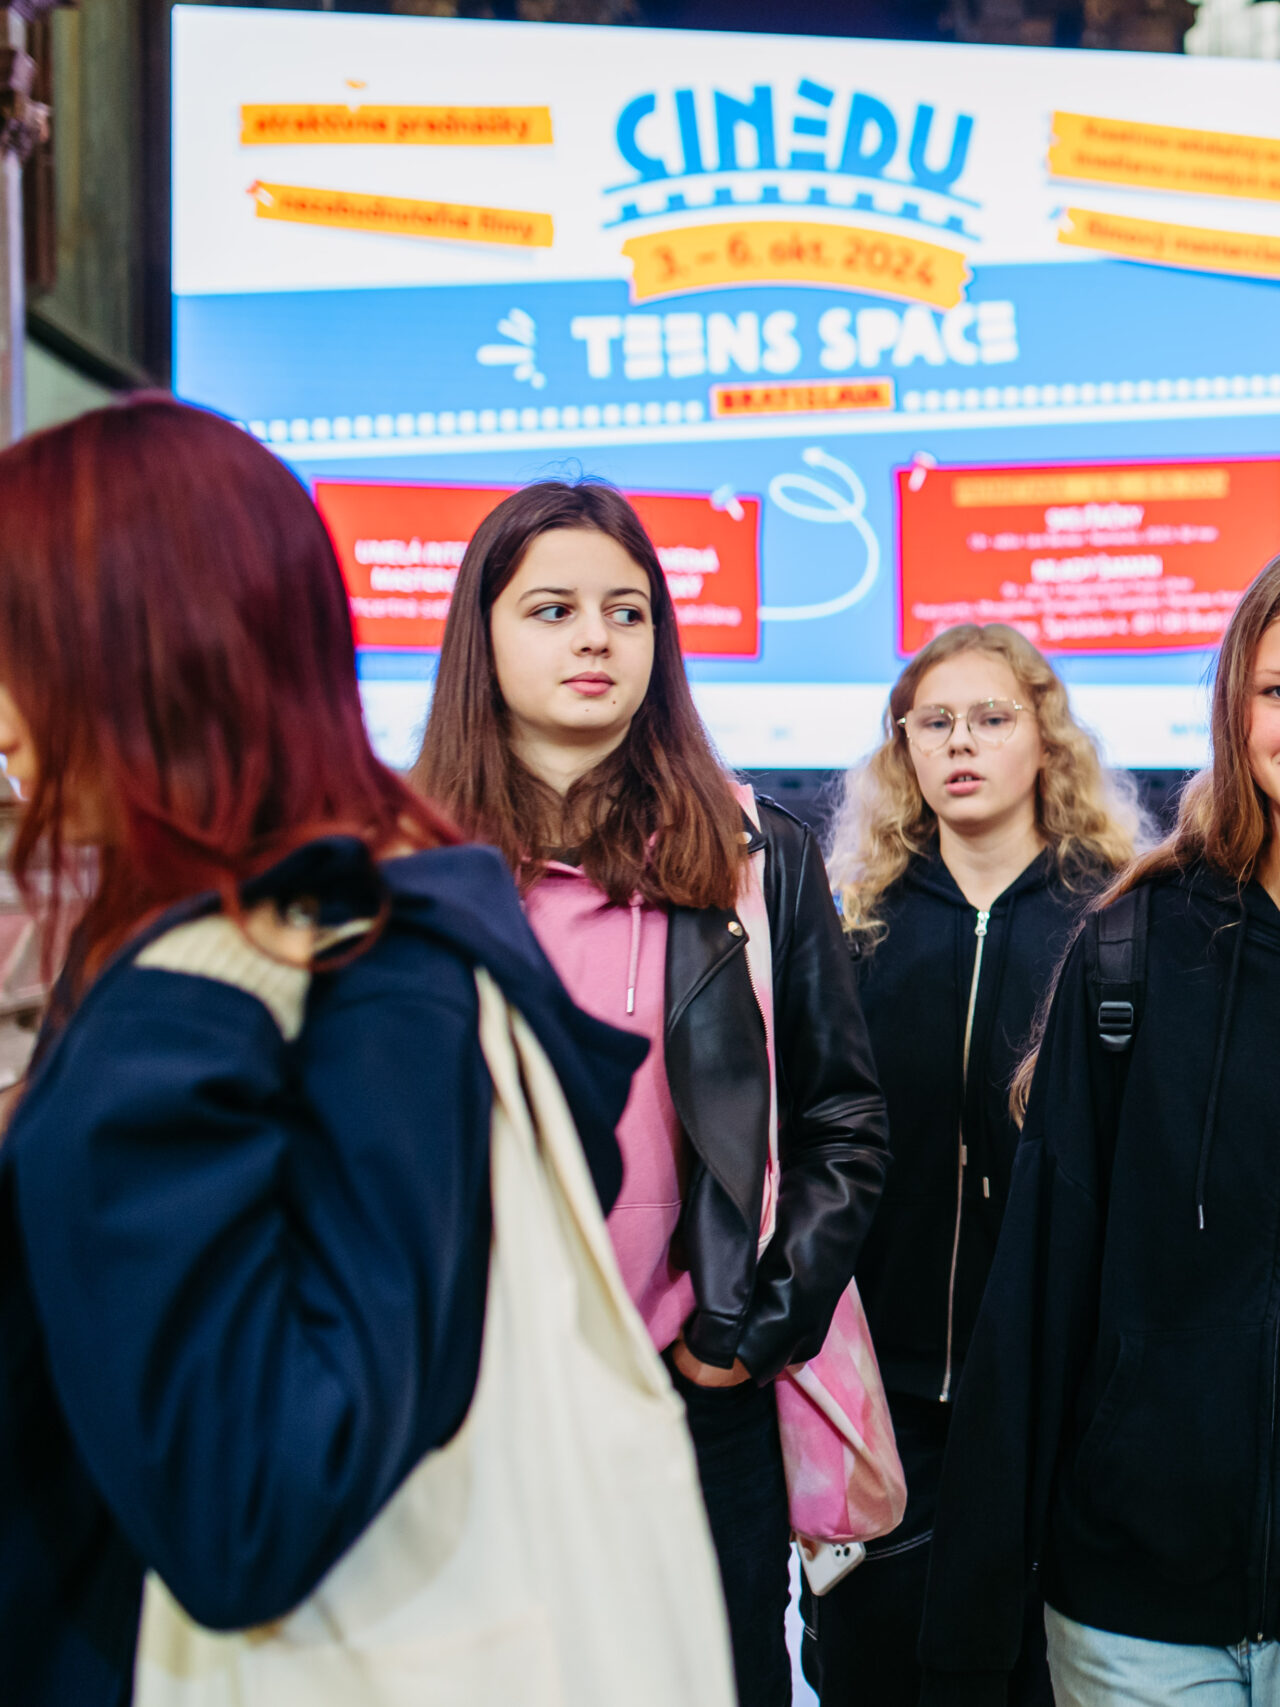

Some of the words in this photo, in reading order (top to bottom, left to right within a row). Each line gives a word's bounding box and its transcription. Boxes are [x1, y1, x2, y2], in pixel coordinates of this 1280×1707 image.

[842, 234, 936, 289] 2024
[571, 309, 800, 381] TEENS
[819, 301, 1020, 369] SPACE
[720, 386, 883, 411] BRATISLAVA
